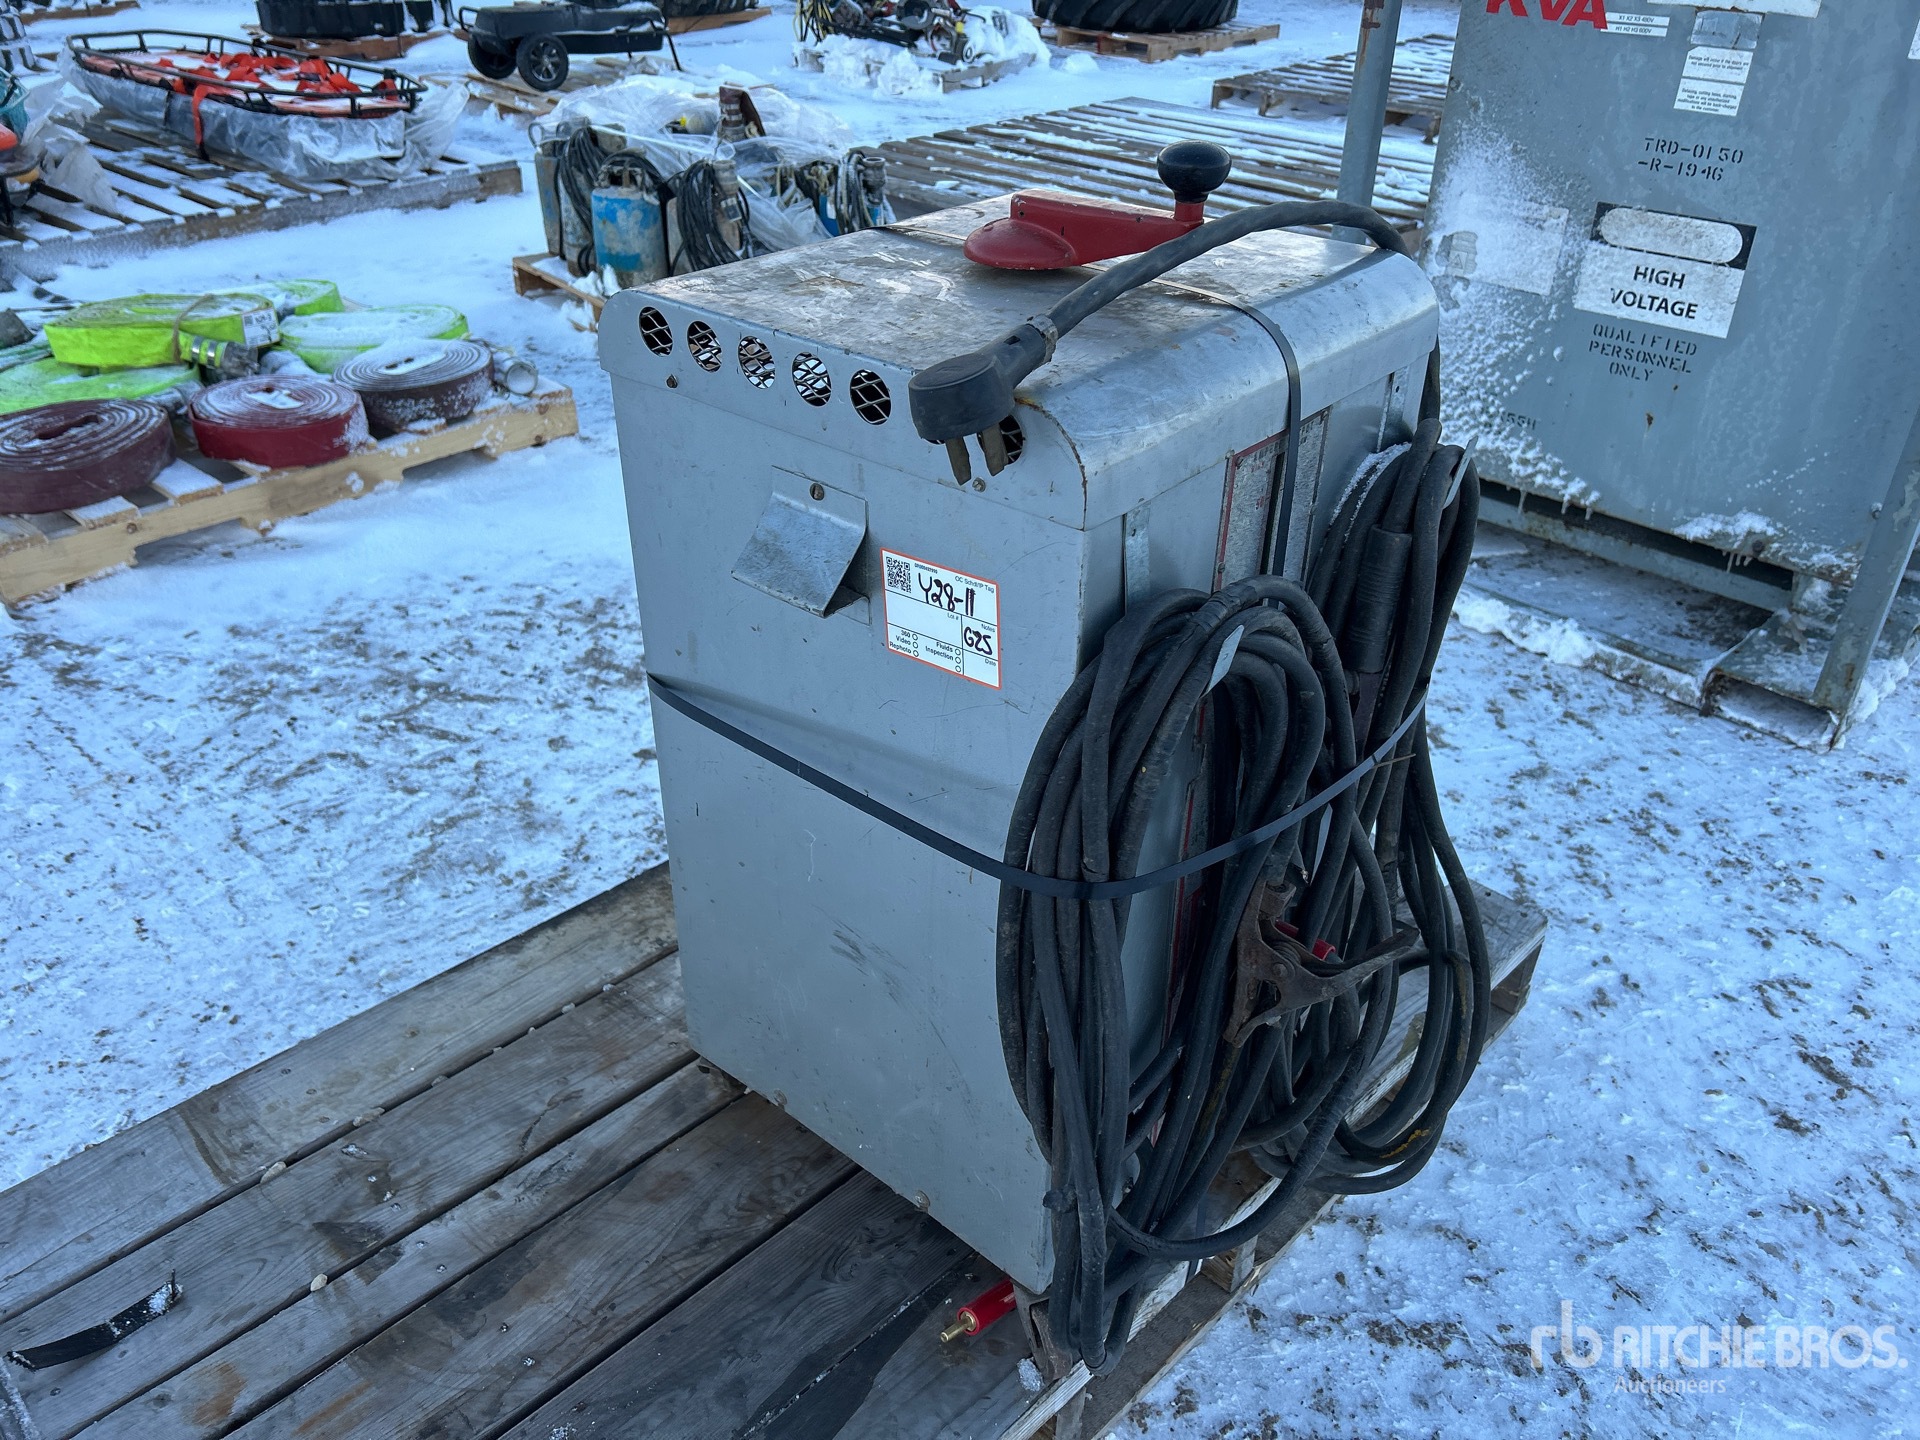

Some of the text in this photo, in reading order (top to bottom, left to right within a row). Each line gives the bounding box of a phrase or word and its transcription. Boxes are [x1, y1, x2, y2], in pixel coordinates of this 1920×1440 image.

[1633, 265, 1686, 289] HIGH
[1610, 288, 1698, 319] VOLTAGE
[1593, 323, 1697, 356] QUALIFIED
[1589, 340, 1692, 373] PERSONNEL
[1609, 362, 1653, 382] ONLY
[985, 583, 995, 594] Tag
[947, 612, 955, 620] Lot
[901, 630, 911, 638] 360
[981, 623, 996, 633] Notes
[896, 635, 911, 645] Video
[889, 641, 912, 654] Rephoto
[925, 646, 954, 661] Inspection
[936, 642, 953, 653] Fluids
[984, 658, 996, 667] Date
